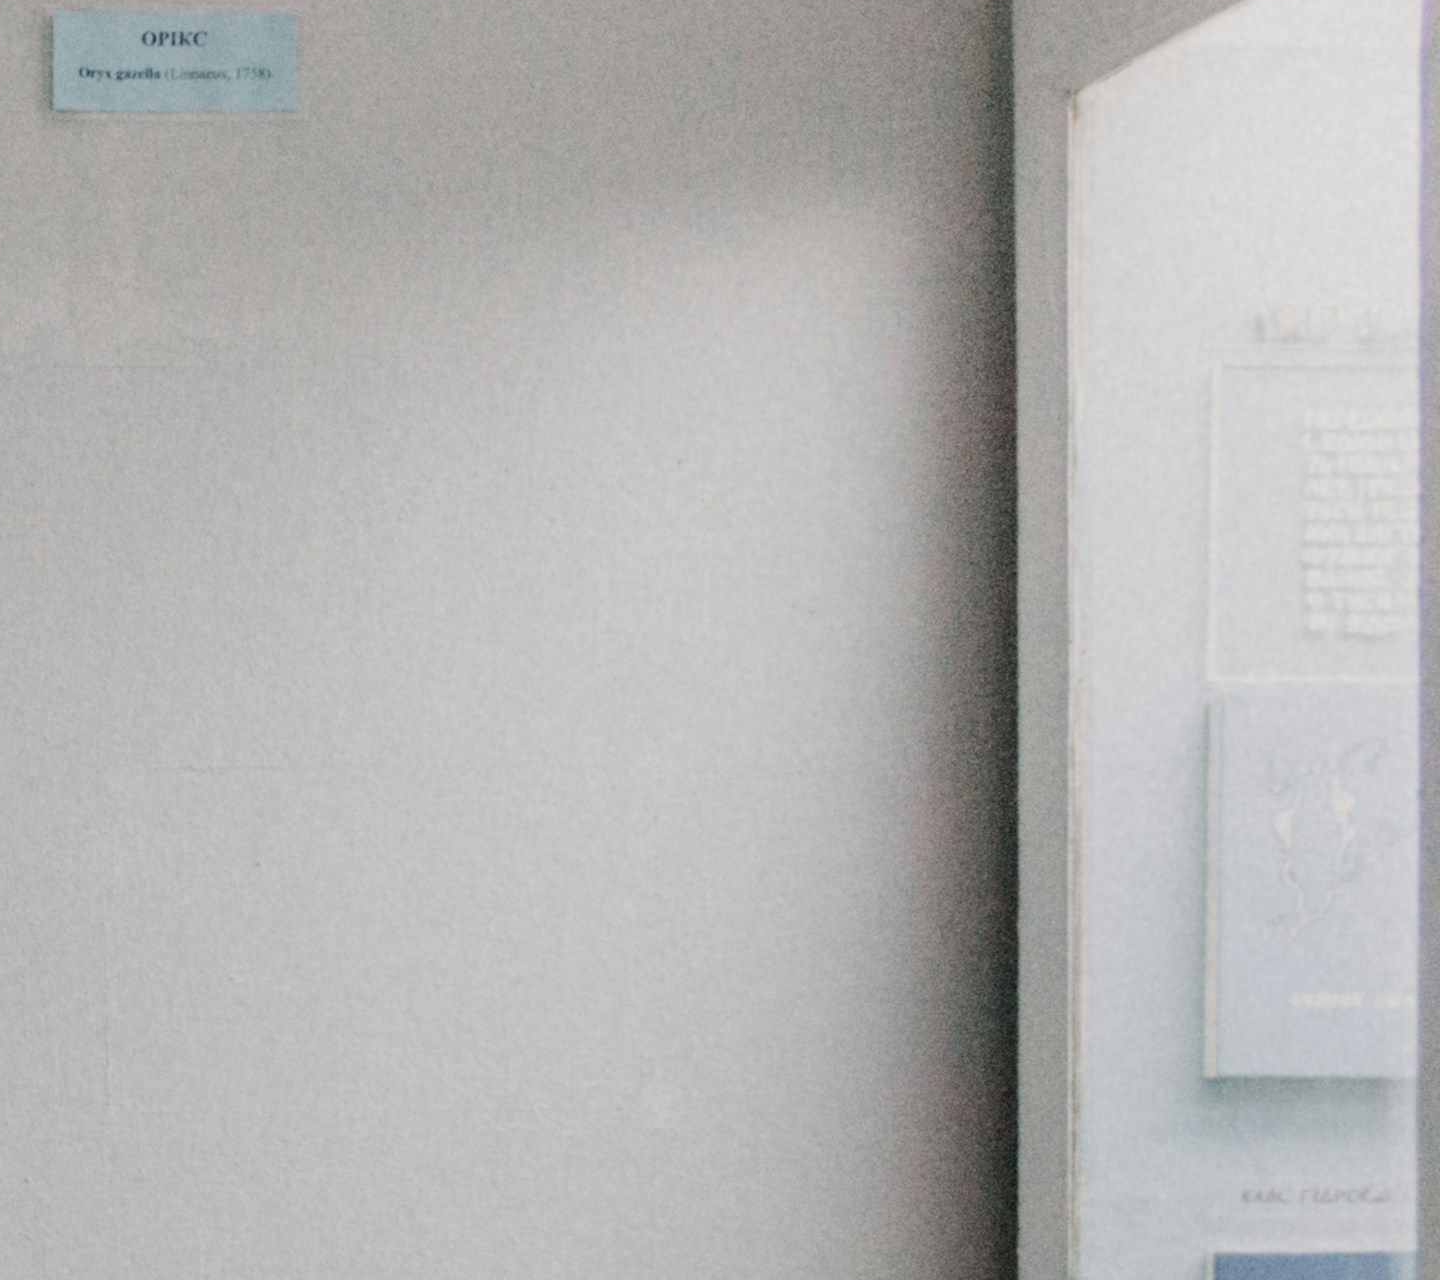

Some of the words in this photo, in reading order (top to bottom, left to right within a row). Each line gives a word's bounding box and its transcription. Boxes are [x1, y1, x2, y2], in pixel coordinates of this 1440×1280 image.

[141, 31, 209, 47] ОРІКС
[78, 67, 111, 82] Oryx
[116, 67, 161, 82] gazella
